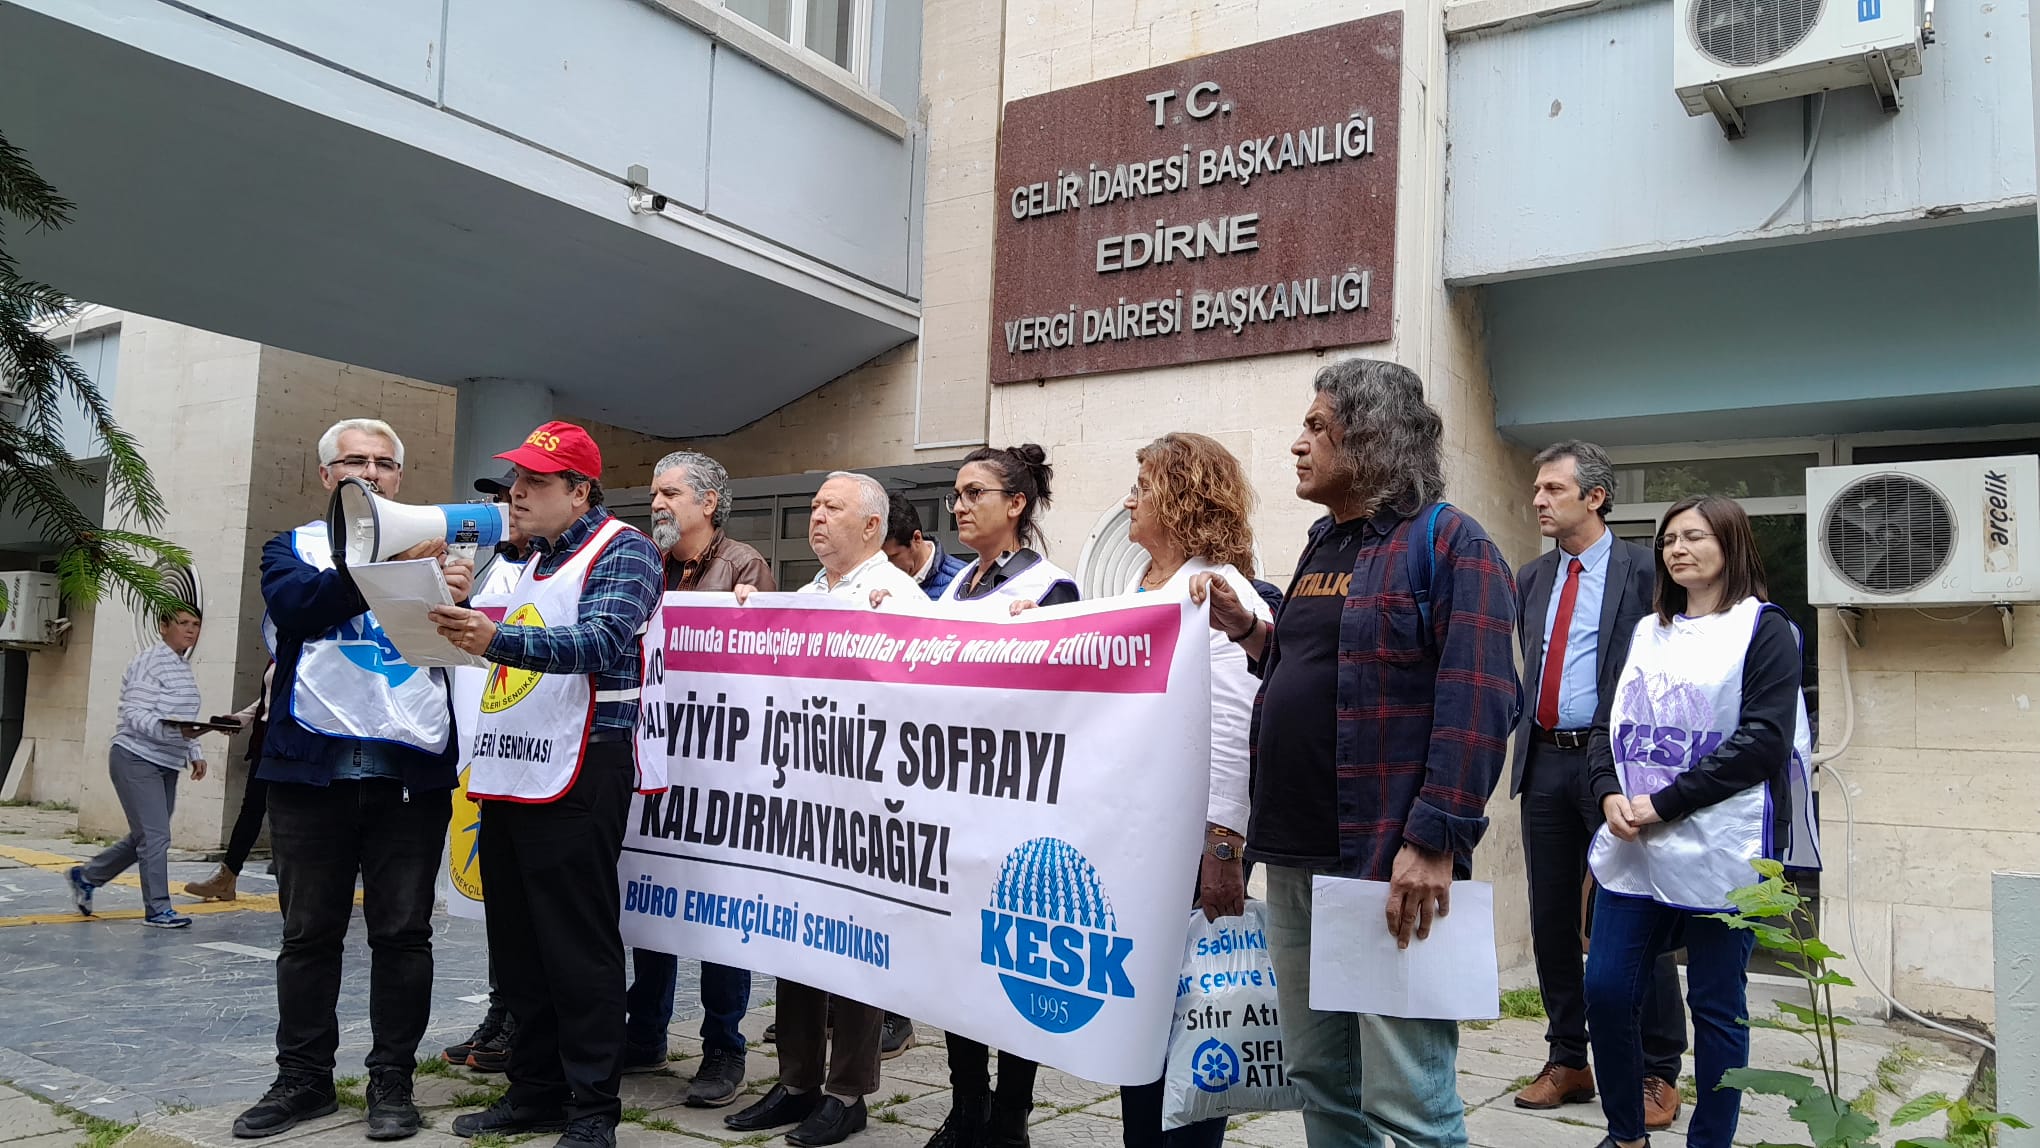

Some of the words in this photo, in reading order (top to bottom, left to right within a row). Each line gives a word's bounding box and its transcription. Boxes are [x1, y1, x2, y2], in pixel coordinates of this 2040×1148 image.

[1011, 170, 1080, 219] GELİR
[1088, 144, 1189, 206] İDARESİ
[1198, 114, 1375, 186] BAŞKANLIĞI
[1095, 212, 1260, 273] EDİRNE
[1004, 305, 1076, 353] VERGİ
[1082, 289, 1182, 344] DAİRESİ
[1191, 267, 1370, 334] BAŞKANLIĞI
[526, 430, 560, 451] BES
[1984, 470, 2014, 546] arçelik
[727, 627, 806, 665] Emekçiler
[807, 631, 823, 657] ve
[825, 629, 906, 663] Yoksullar
[1048, 631, 1152, 670] Ediliyor!
[498, 730, 553, 764] SENDİKASI
[666, 690, 750, 763] YİYİP
[760, 695, 888, 789] İÇTİĞİNİZ
[897, 721, 1066, 805] SOFRAYI
[639, 784, 952, 895] KALDIRMAYACAĞIZ!
[624, 874, 678, 918] BÜRO
[683, 893, 799, 944] EMEKÇİLERİ
[802, 912, 890, 970] SENDİKASI
[980, 909, 1136, 999] KESK
[1028, 991, 1070, 1026] 1995
[1200, 968, 1262, 994] çevre
